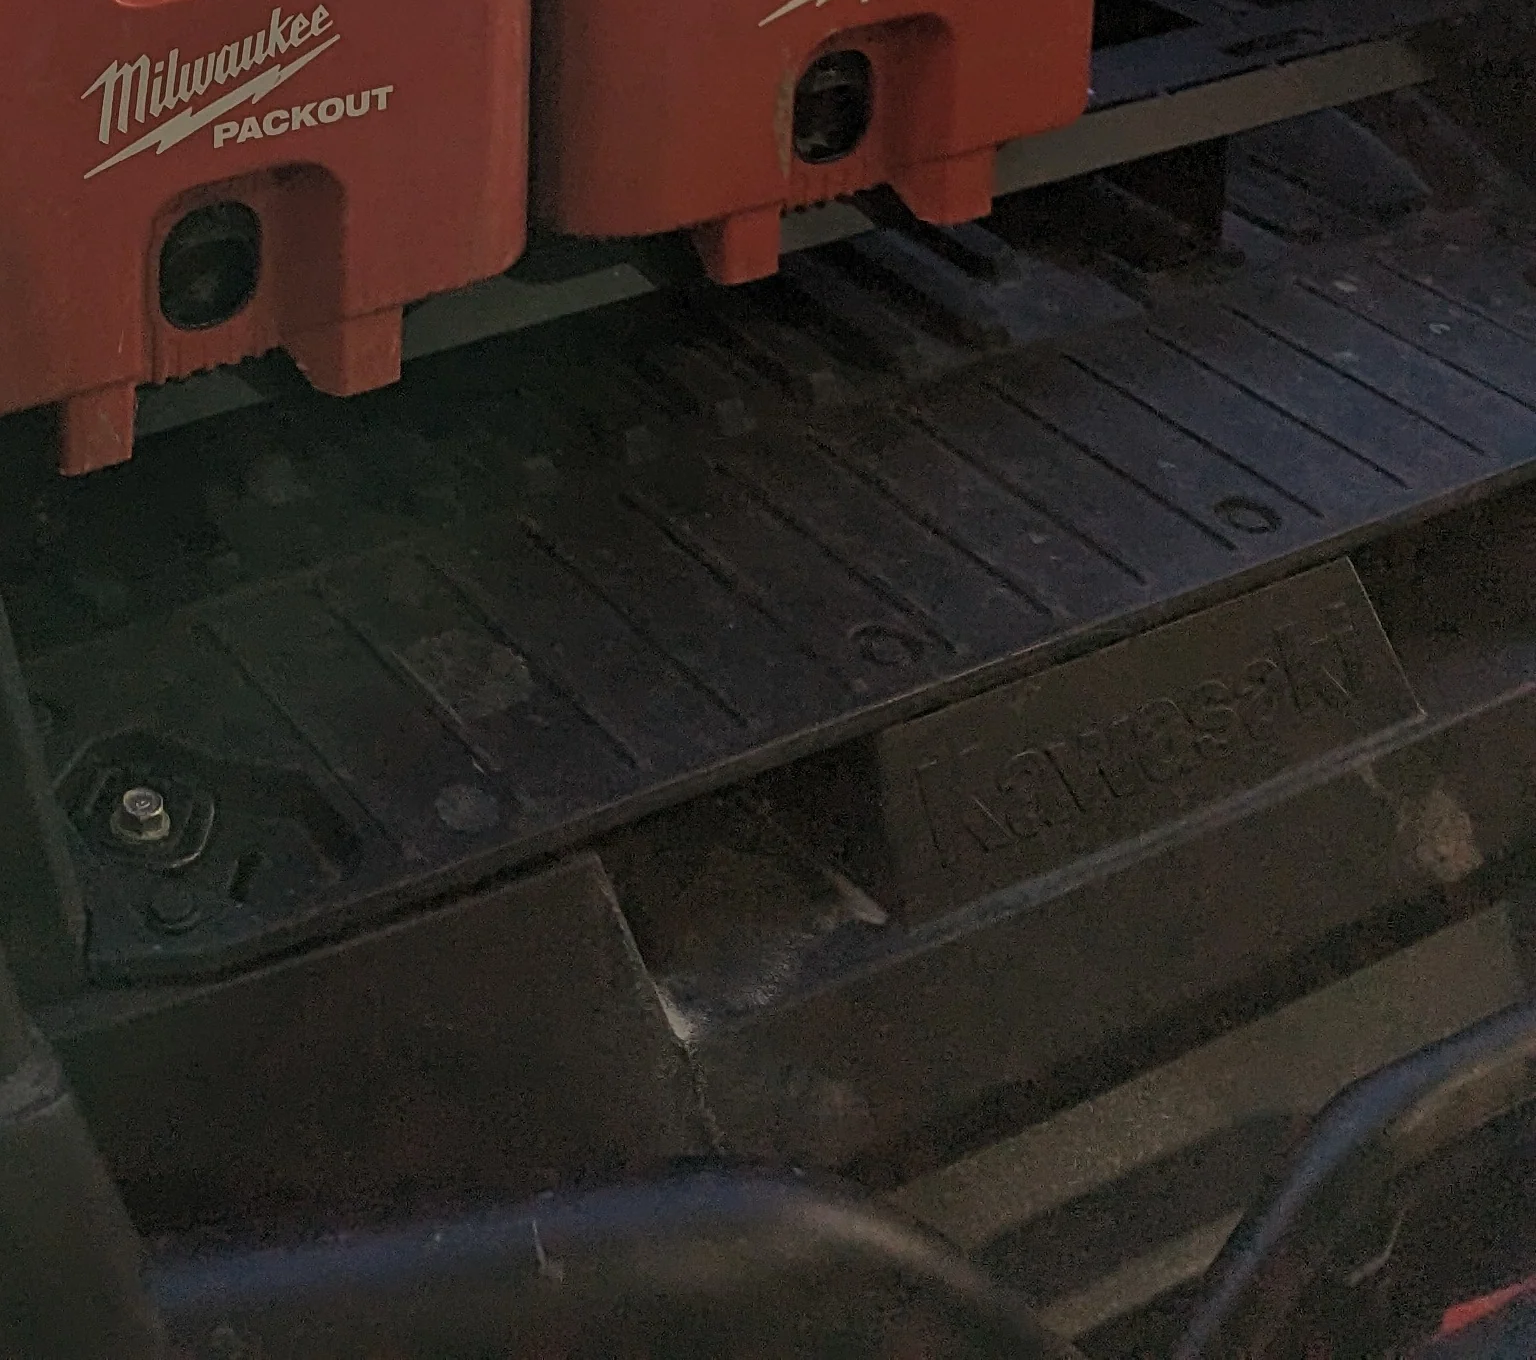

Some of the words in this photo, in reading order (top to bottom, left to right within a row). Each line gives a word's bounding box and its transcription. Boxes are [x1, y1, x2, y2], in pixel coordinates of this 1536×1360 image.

[81, 3, 333, 145] Milwaukee
[214, 85, 394, 149] PACKOUT
[907, 596, 1364, 870] Kawasaki
